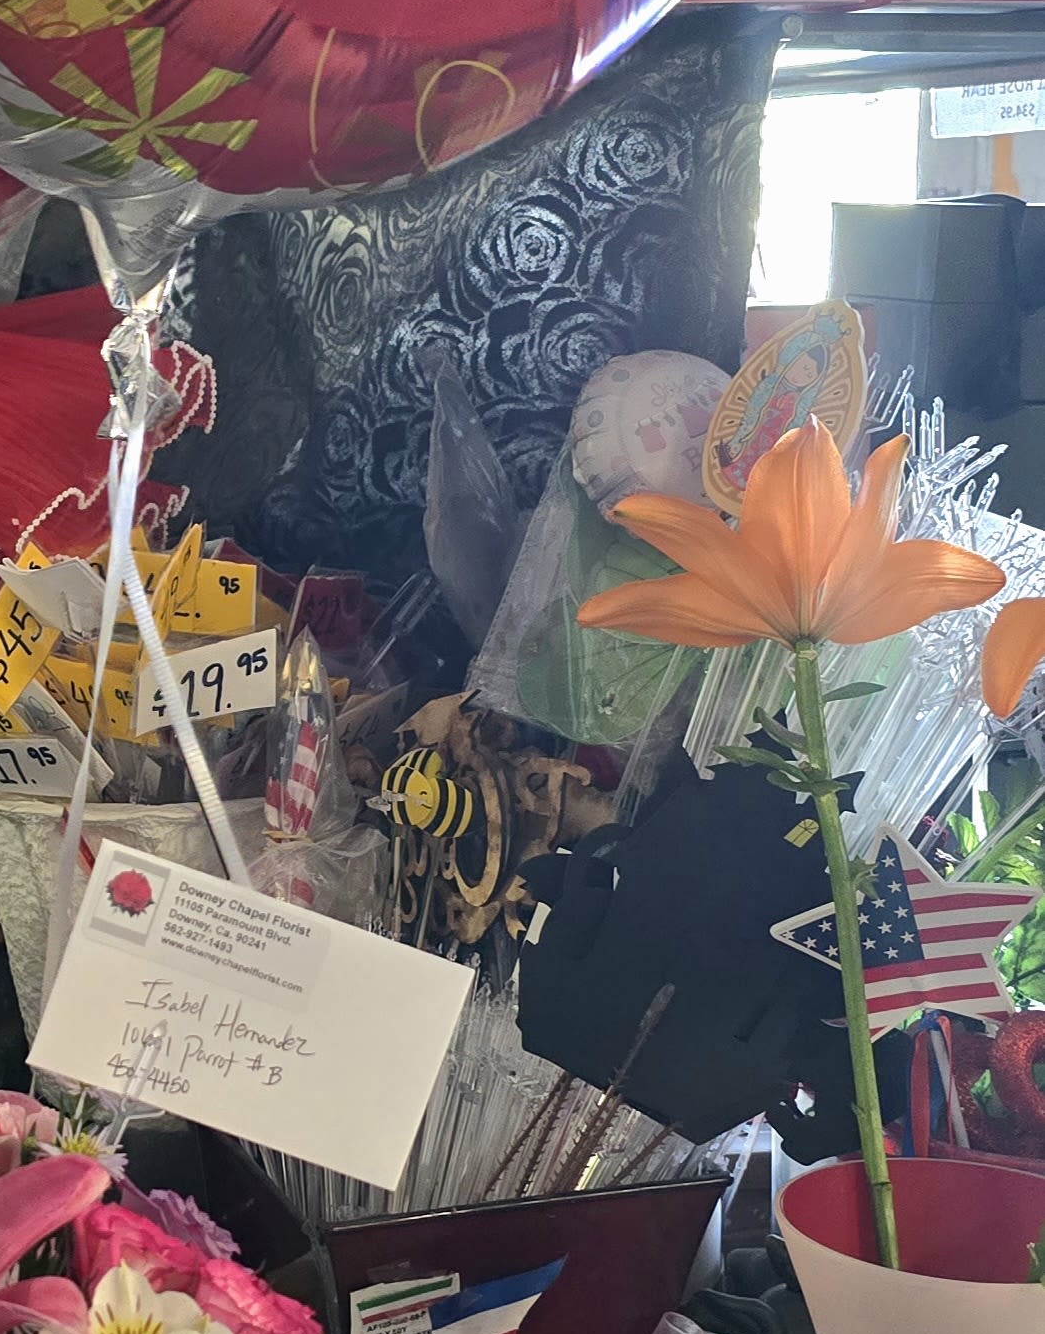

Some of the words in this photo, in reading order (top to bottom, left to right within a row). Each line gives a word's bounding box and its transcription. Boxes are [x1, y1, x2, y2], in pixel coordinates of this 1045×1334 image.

[168, 908, 213, 933] Downey,
[215, 925, 233, 940] Ca.
[235, 932, 267, 952] 90241
[173, 896, 204, 913] 11105
[205, 907, 264, 938] Paramount
[265, 928, 292, 946] Blvd.
[179, 880, 227, 908] Downey
[228, 899, 271, 924] Chapel
[271, 914, 312, 938] Florist
[163, 922, 234, 954] 562-927-1493
[160, 936, 304, 994] www.downeychapelflorist.com
[125, 979, 208, 1021] Isabel
[179, 1034, 241, 1078] Parrot
